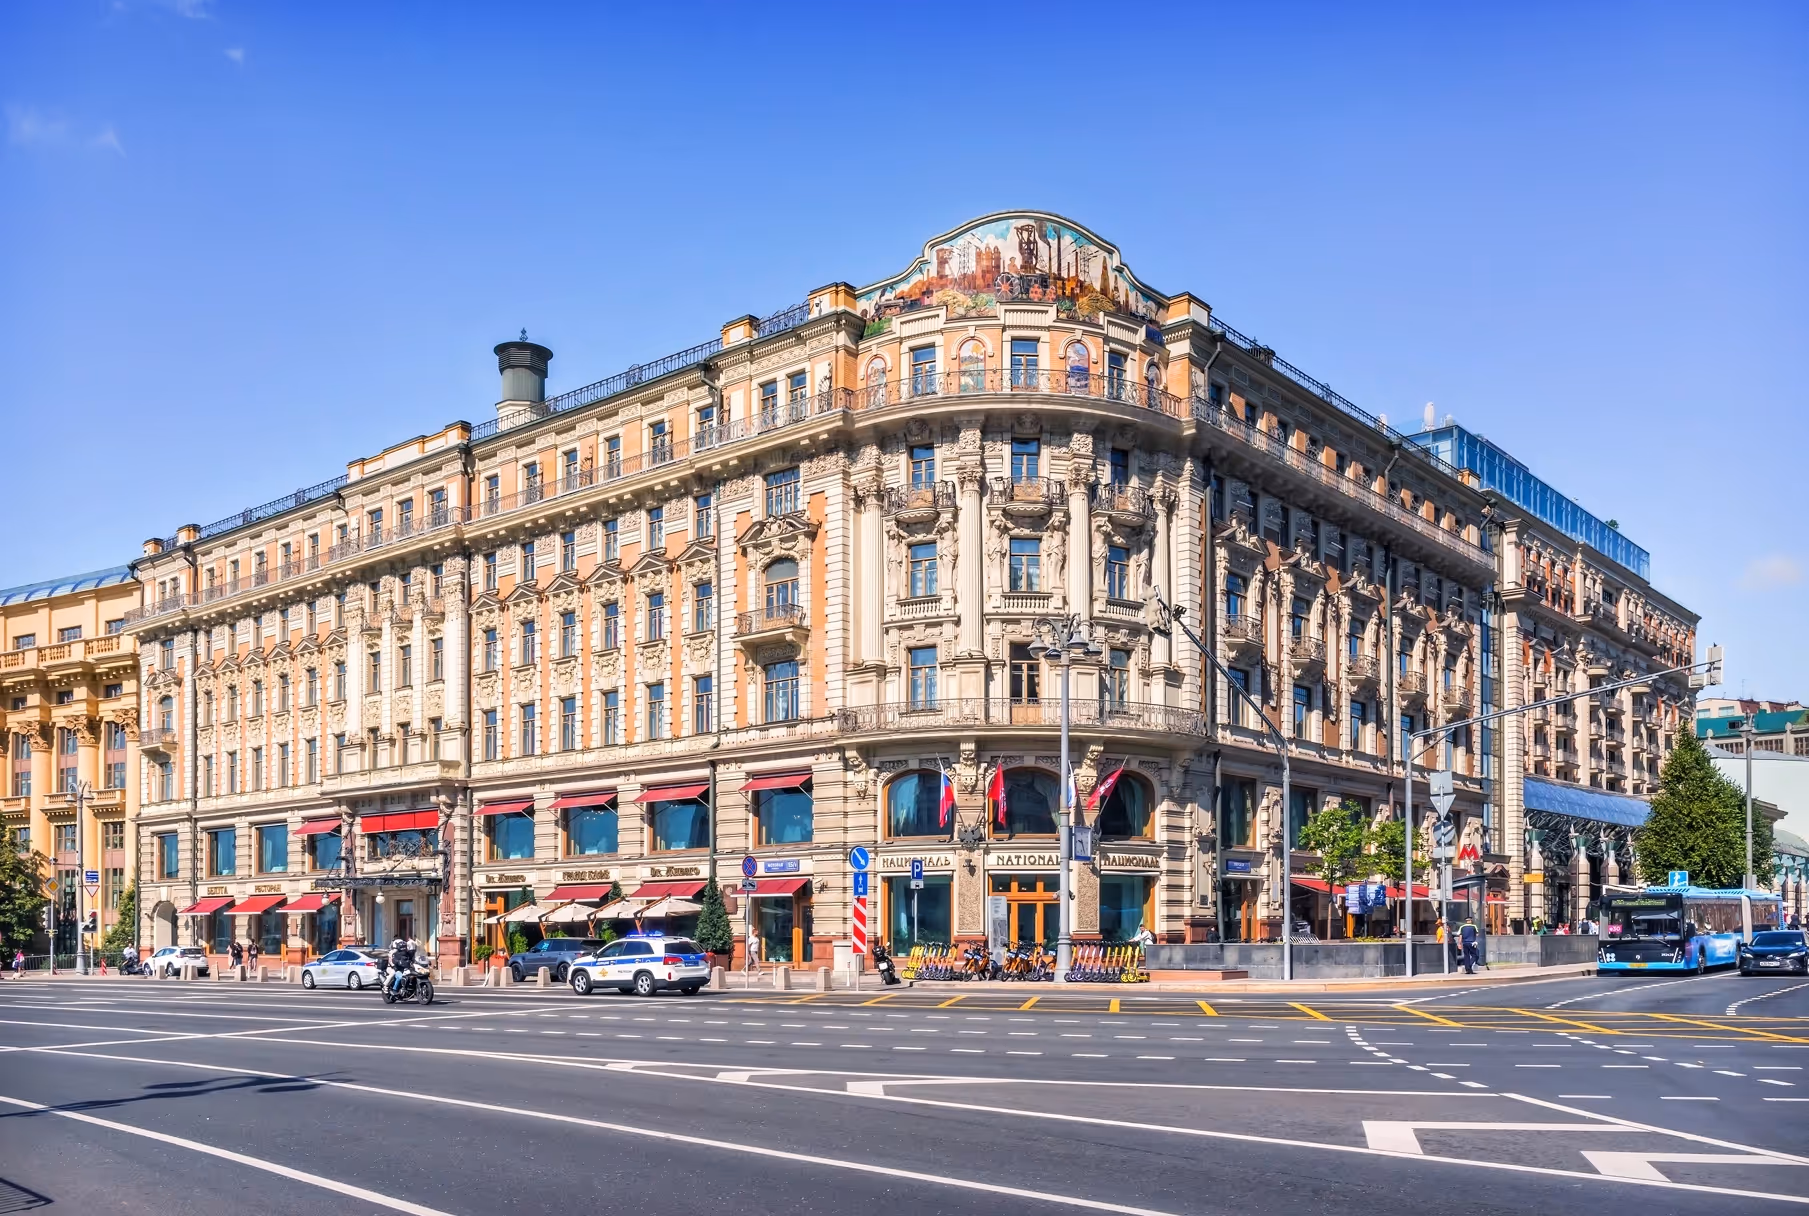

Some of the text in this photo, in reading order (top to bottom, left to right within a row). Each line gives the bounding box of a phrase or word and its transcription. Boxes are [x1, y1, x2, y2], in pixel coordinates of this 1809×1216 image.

[882, 856, 951, 868] НАЦИНАЛЬ
[997, 854, 1060, 866] NATIONAL
[254, 884, 282, 893] РЕСТОРАН
